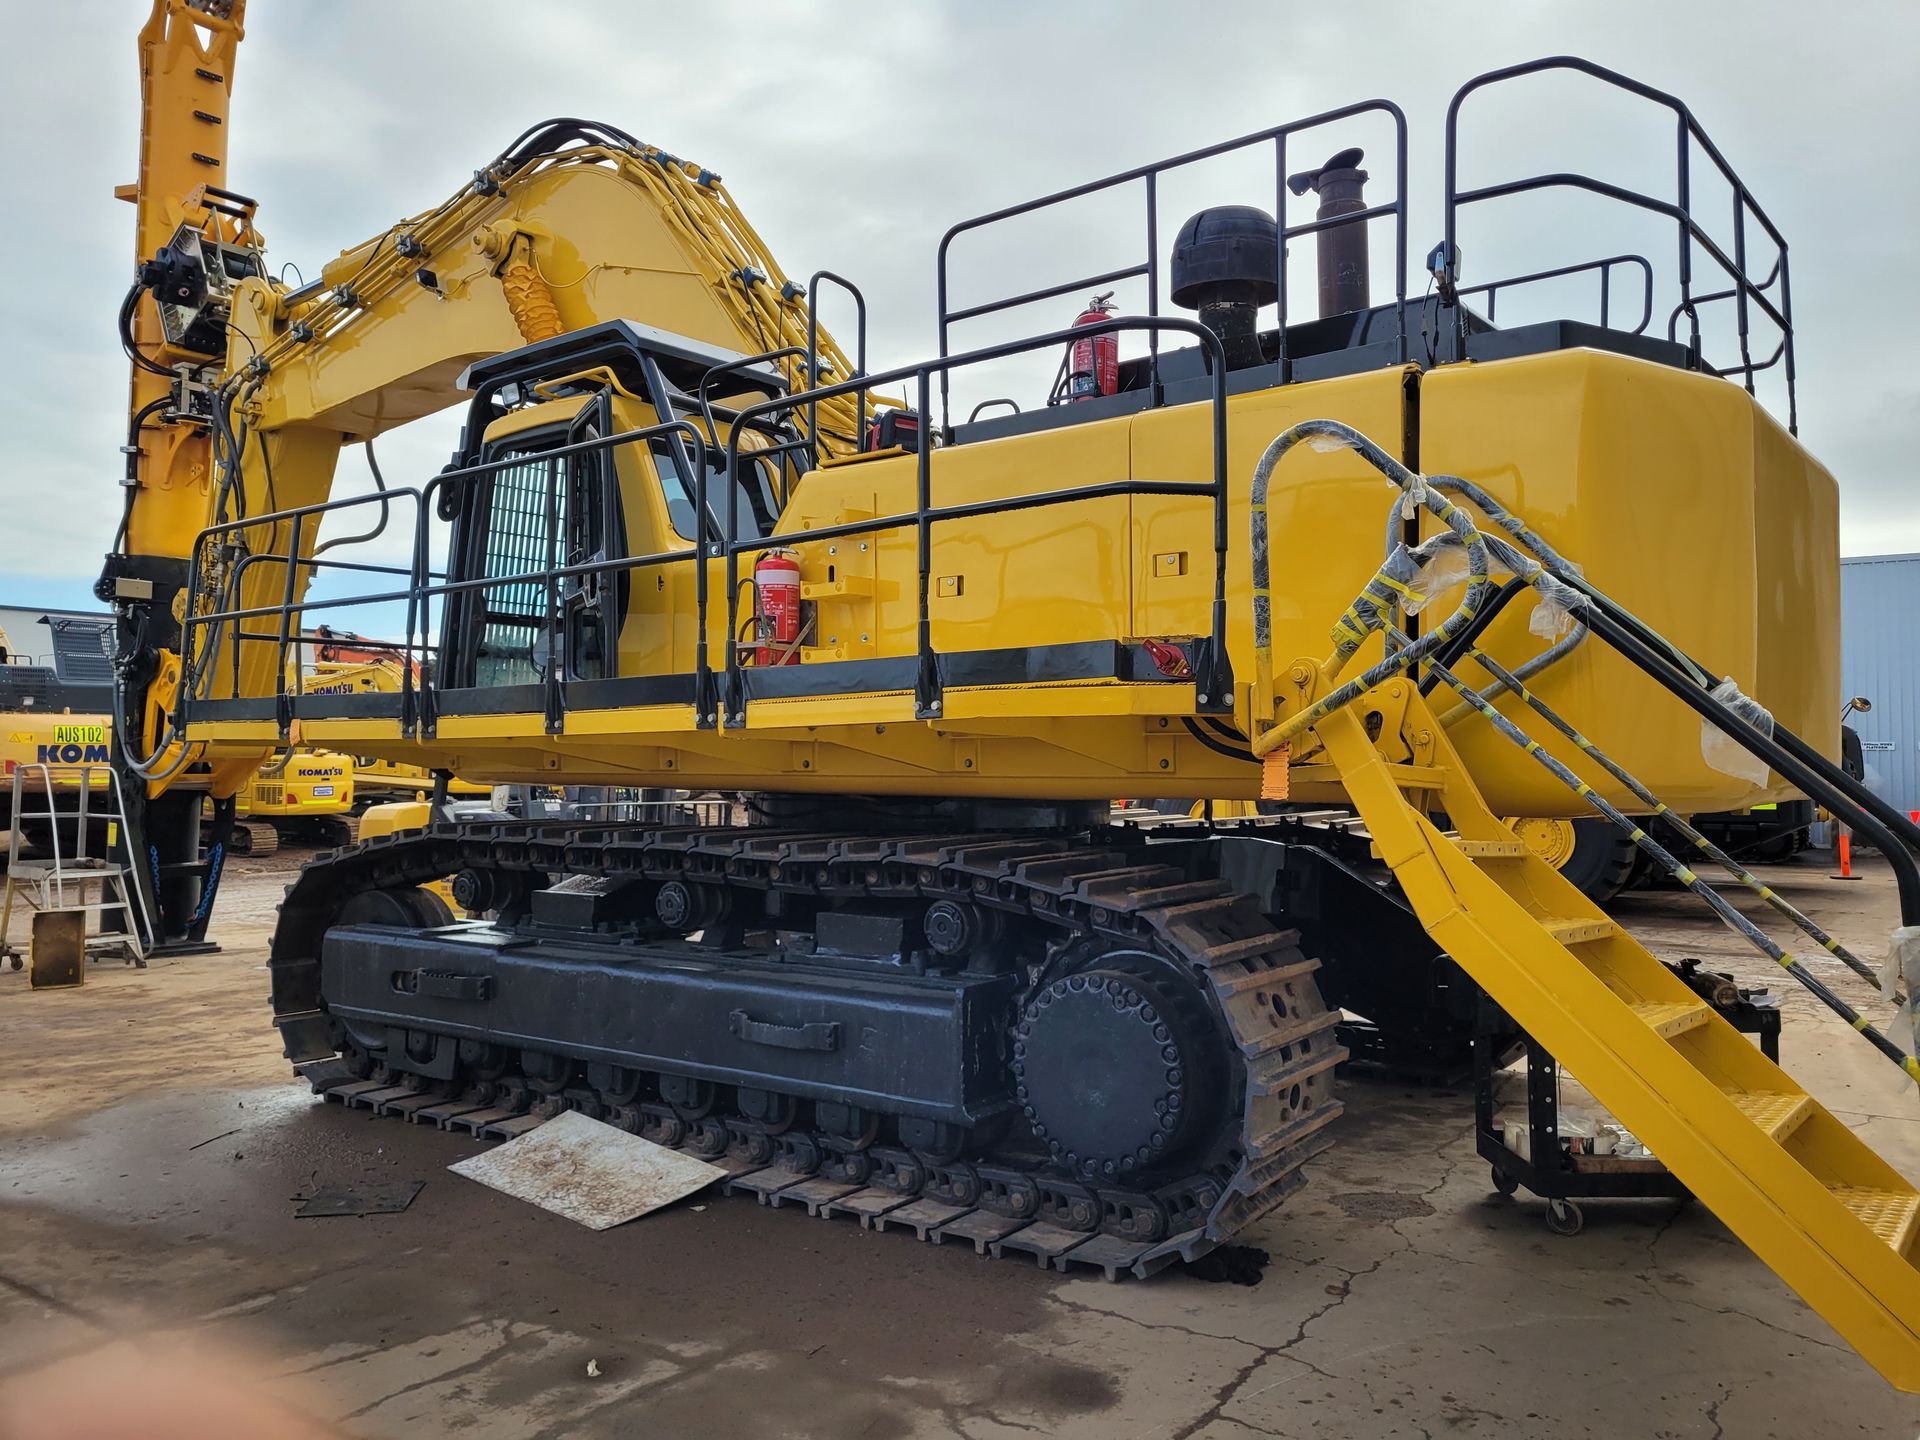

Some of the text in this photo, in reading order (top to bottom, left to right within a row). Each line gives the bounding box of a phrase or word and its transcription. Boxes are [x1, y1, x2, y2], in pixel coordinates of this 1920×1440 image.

[313, 682, 353, 695] KOMATSU
[56, 727, 102, 742] AUS102
[298, 767, 343, 776] KOMATSU
